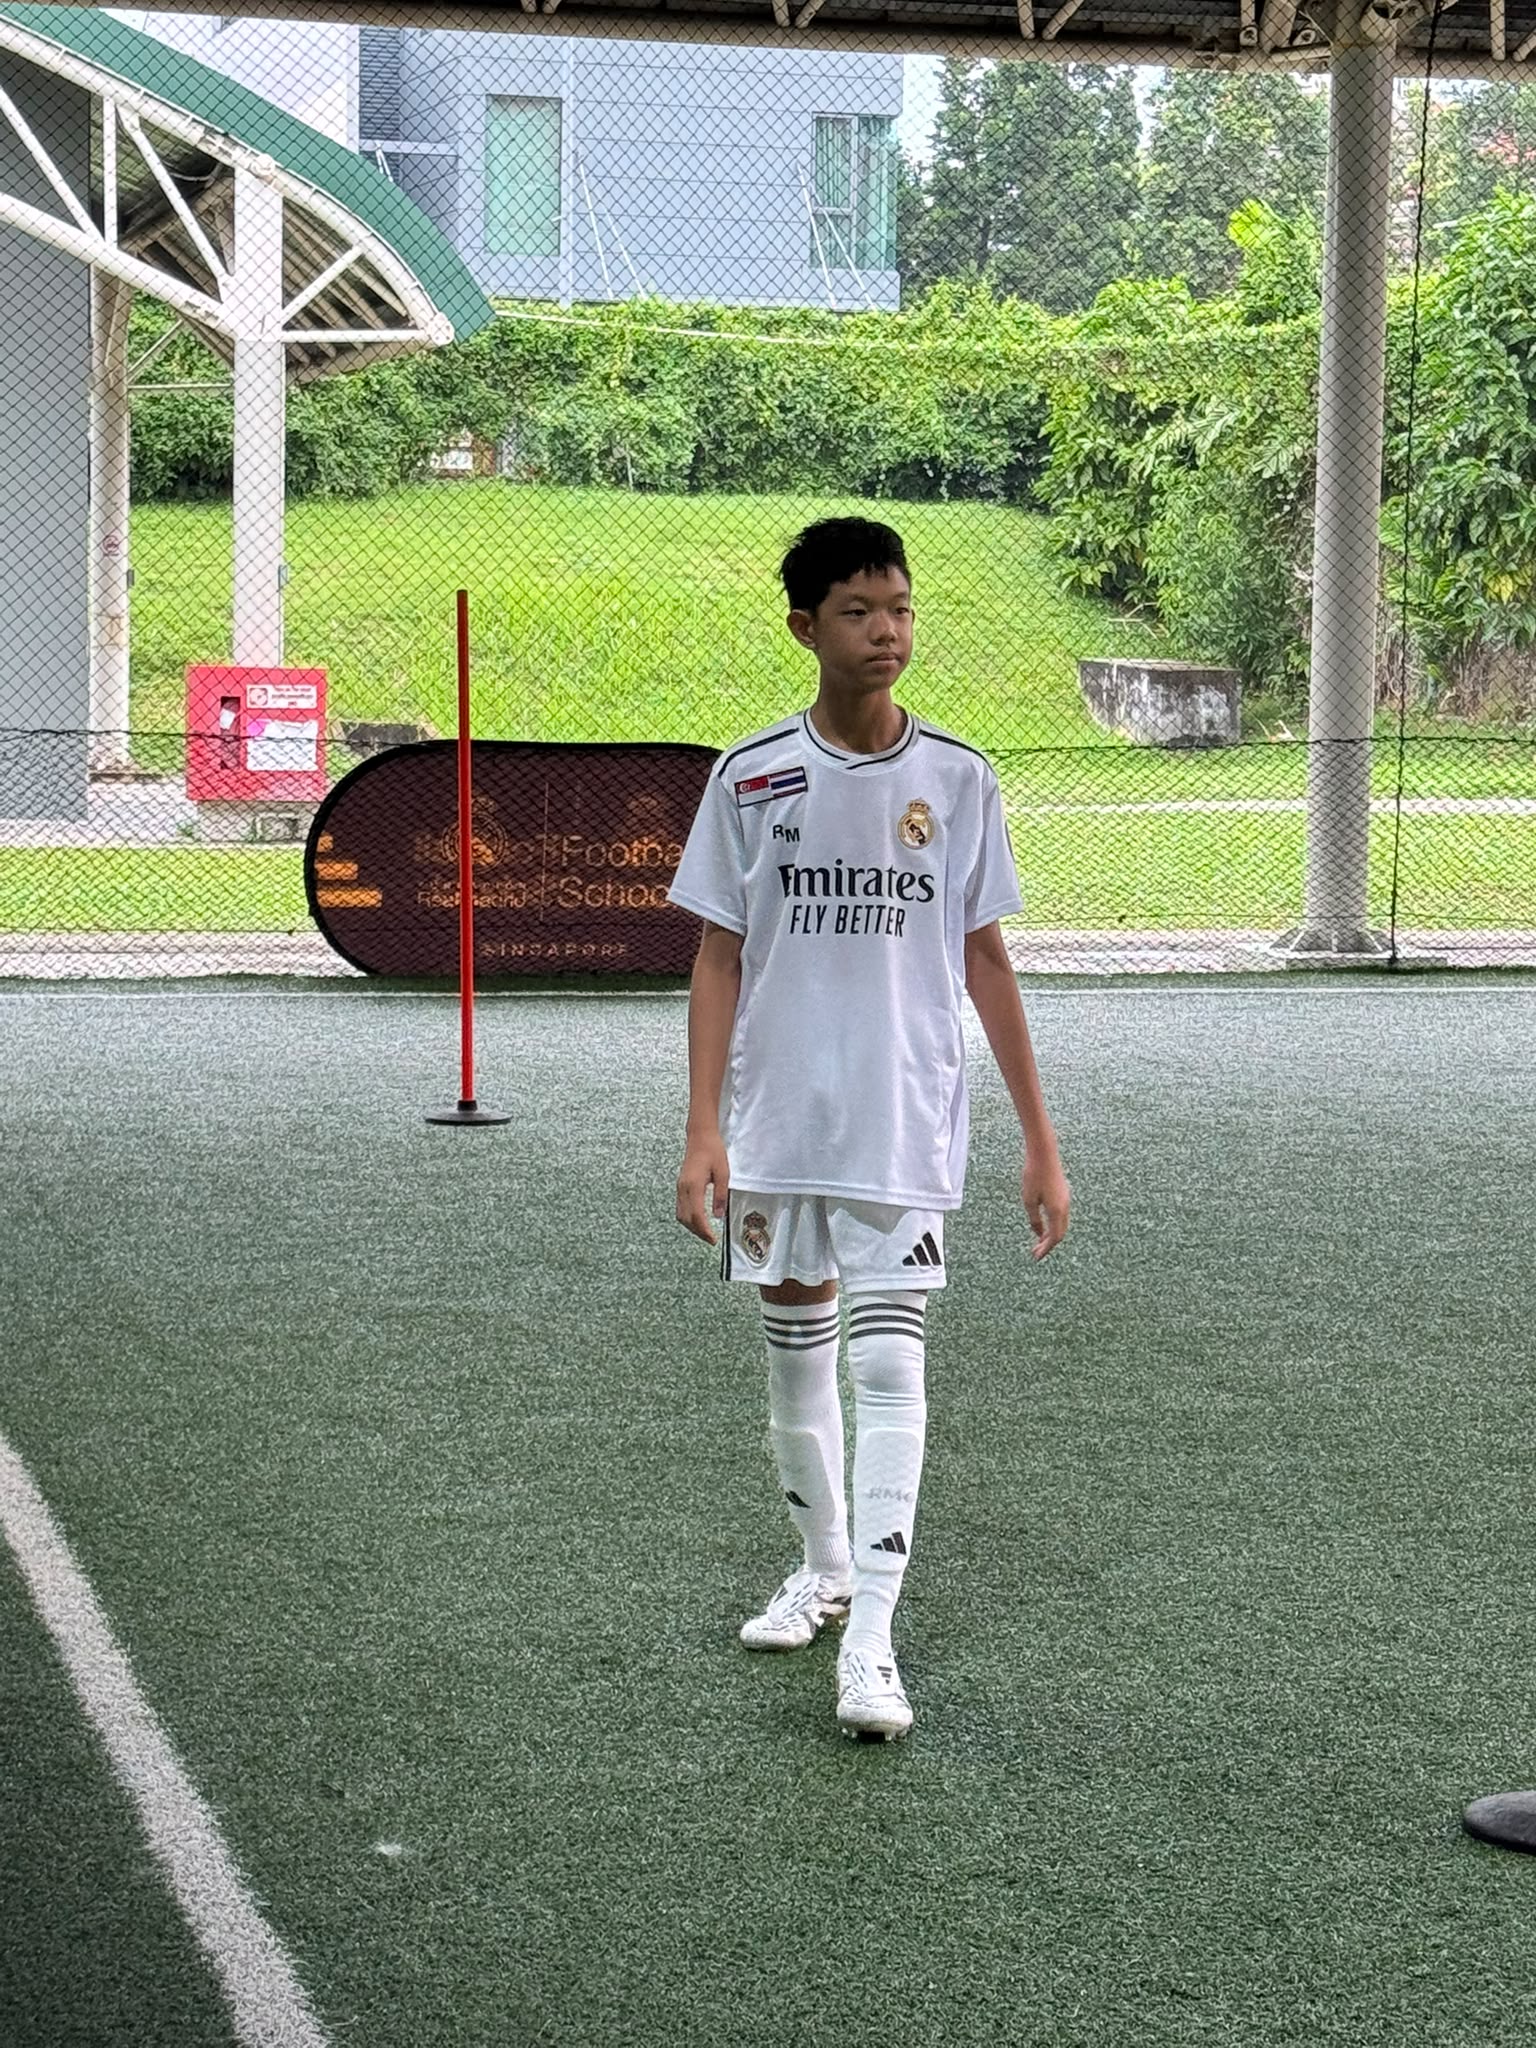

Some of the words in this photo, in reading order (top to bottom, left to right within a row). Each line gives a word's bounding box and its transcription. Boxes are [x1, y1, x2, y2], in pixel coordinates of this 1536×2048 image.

[772, 824, 800, 843] RM
[562, 835, 684, 867] Footba
[558, 875, 677, 908] Schoo
[777, 858, 935, 903] Emirates
[789, 904, 827, 935] FLY
[834, 904, 906, 938] BETTER
[480, 943, 626, 956] SINGAPORE
